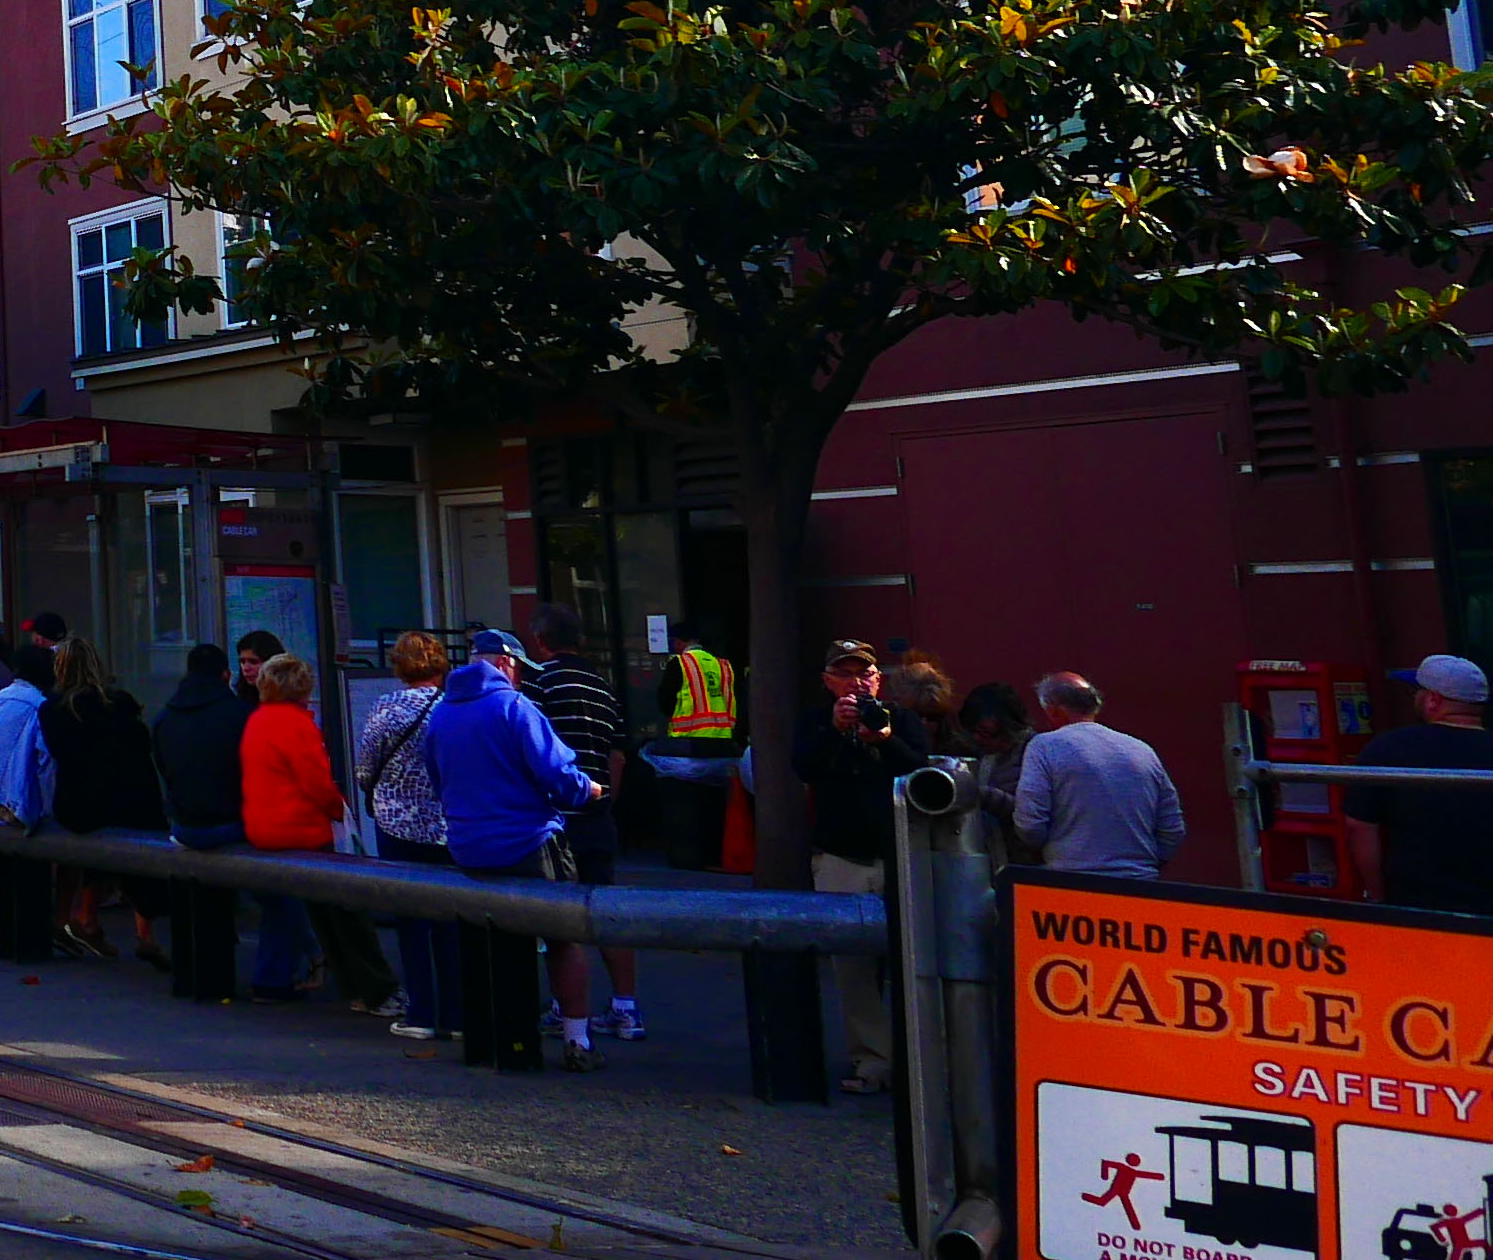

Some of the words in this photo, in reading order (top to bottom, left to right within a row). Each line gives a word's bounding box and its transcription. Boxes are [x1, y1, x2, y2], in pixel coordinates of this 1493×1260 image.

[1032, 910, 1168, 955] WORLD
[1181, 927, 1348, 976] FAMOUS
[1032, 956, 1363, 1054] CABLE
[1252, 1061, 1481, 1123] SAFETY
[1097, 1232, 1126, 1250] DO
[1133, 1237, 1176, 1258] NOT
